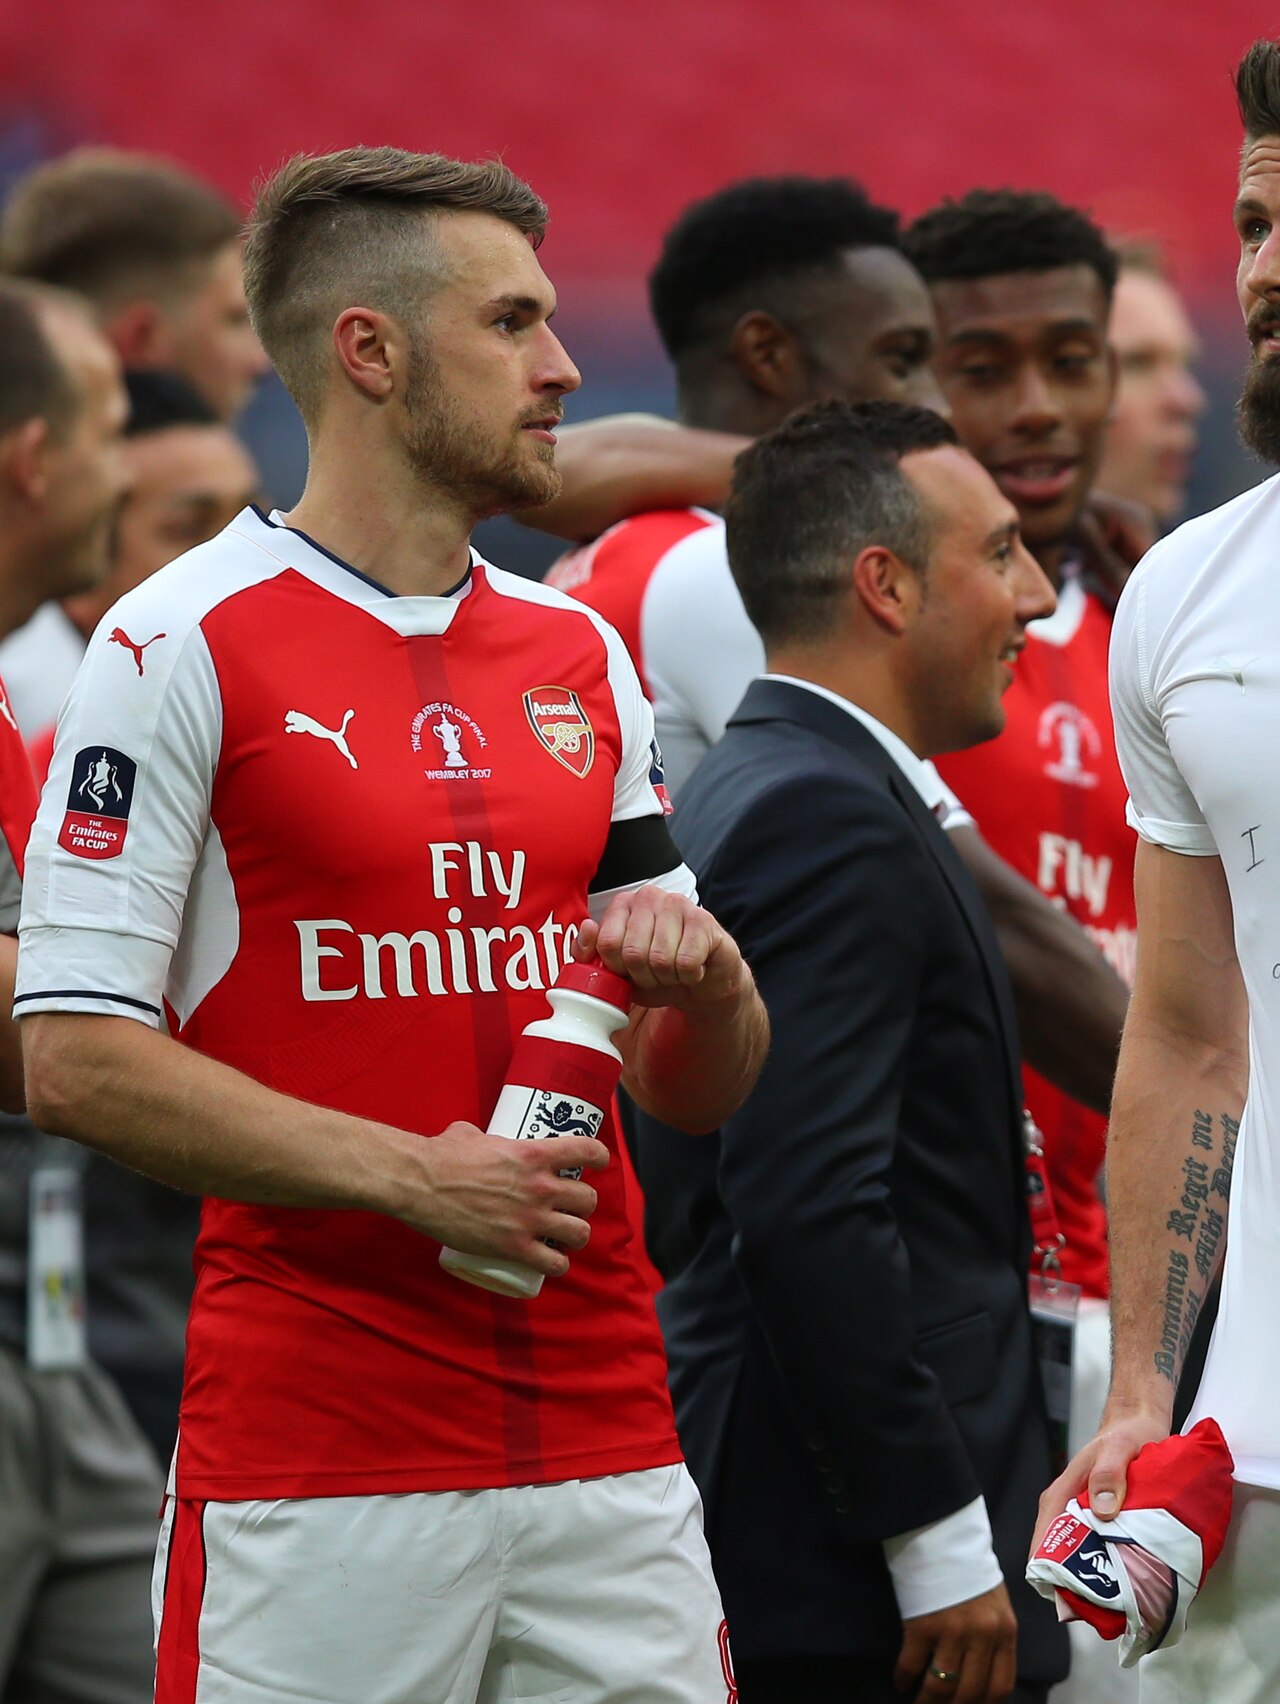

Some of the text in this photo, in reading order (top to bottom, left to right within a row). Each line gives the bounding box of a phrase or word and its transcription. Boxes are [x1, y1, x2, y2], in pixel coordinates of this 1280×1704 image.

[533, 701, 579, 716] Arsenal
[411, 702, 488, 753] THE EMIRATES FA CUP FINAL
[424, 768, 492, 780] WEMBLEY 2017
[68, 824, 119, 841] Emirates
[88, 819, 103, 828] THE
[72, 836, 108, 850] FA CUP
[1241, 824, 1265, 872] I
[427, 841, 526, 909] Fly
[1039, 833, 1112, 917] Fly
[1192, 1109, 1213, 1150] me
[1045, 1518, 1080, 1554] Emirates
